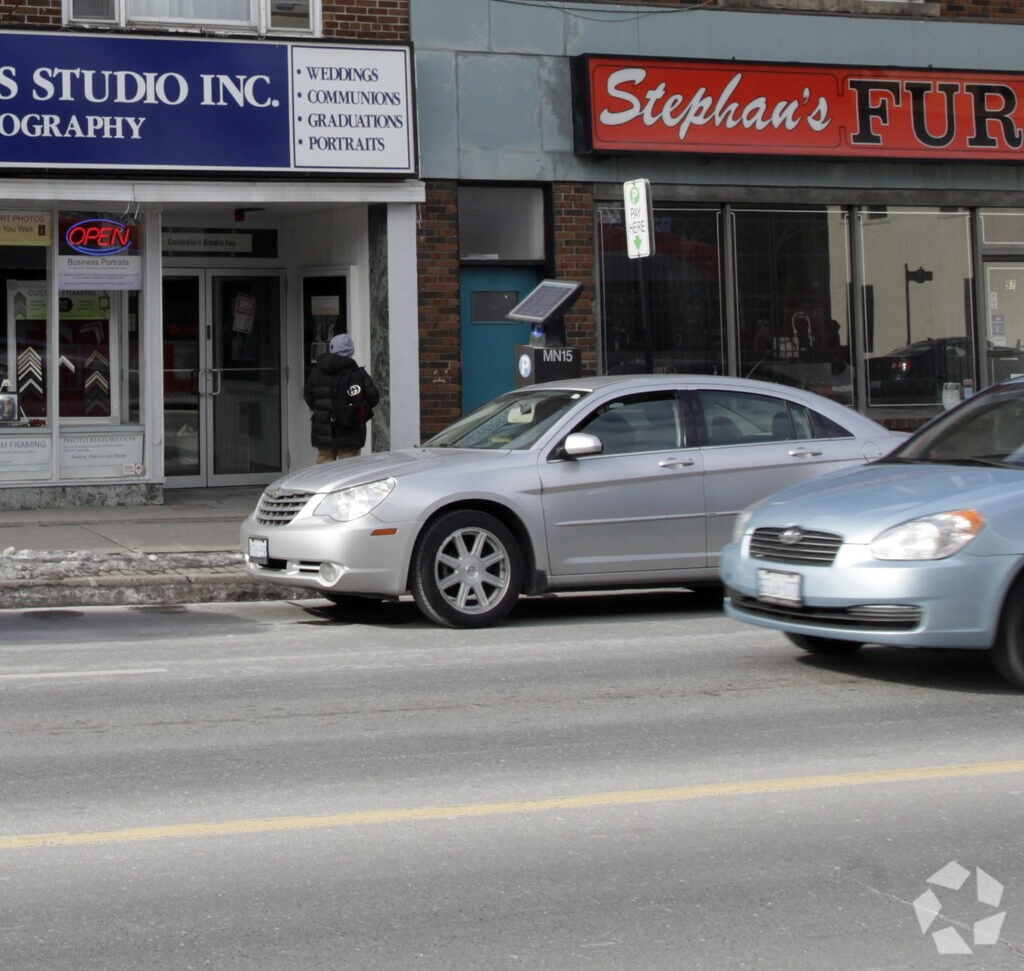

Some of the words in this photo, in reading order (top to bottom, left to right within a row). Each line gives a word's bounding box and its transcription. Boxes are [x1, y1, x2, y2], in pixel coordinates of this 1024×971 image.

[306, 66, 379, 82] WEDDINGS
[32, 67, 189, 105] STUDIO
[200, 74, 280, 108] INC.
[307, 89, 401, 106] COMMUNIONS
[599, 67, 832, 140] Stephan's
[848, 78, 1024, 150] FUR
[308, 113, 404, 129] GRADUATIONS
[308, 136, 386, 152] PORTRAITS
[12, 214, 45, 223] PHOTOS
[629, 208, 641, 219] PAY
[2, 225, 16, 233] You
[18, 225, 34, 233] Wait
[629, 221, 646, 234] HERE
[68, 226, 131, 247] OPEN
[168, 238, 201, 246] Custodio's
[203, 238, 224, 246] Studio
[67, 258, 99, 266] Business
[100, 258, 130, 266] Portraits
[543, 349, 573, 362] MN15
[9, 440, 46, 449] FRAMING
[63, 436, 89, 444] PHOTO
